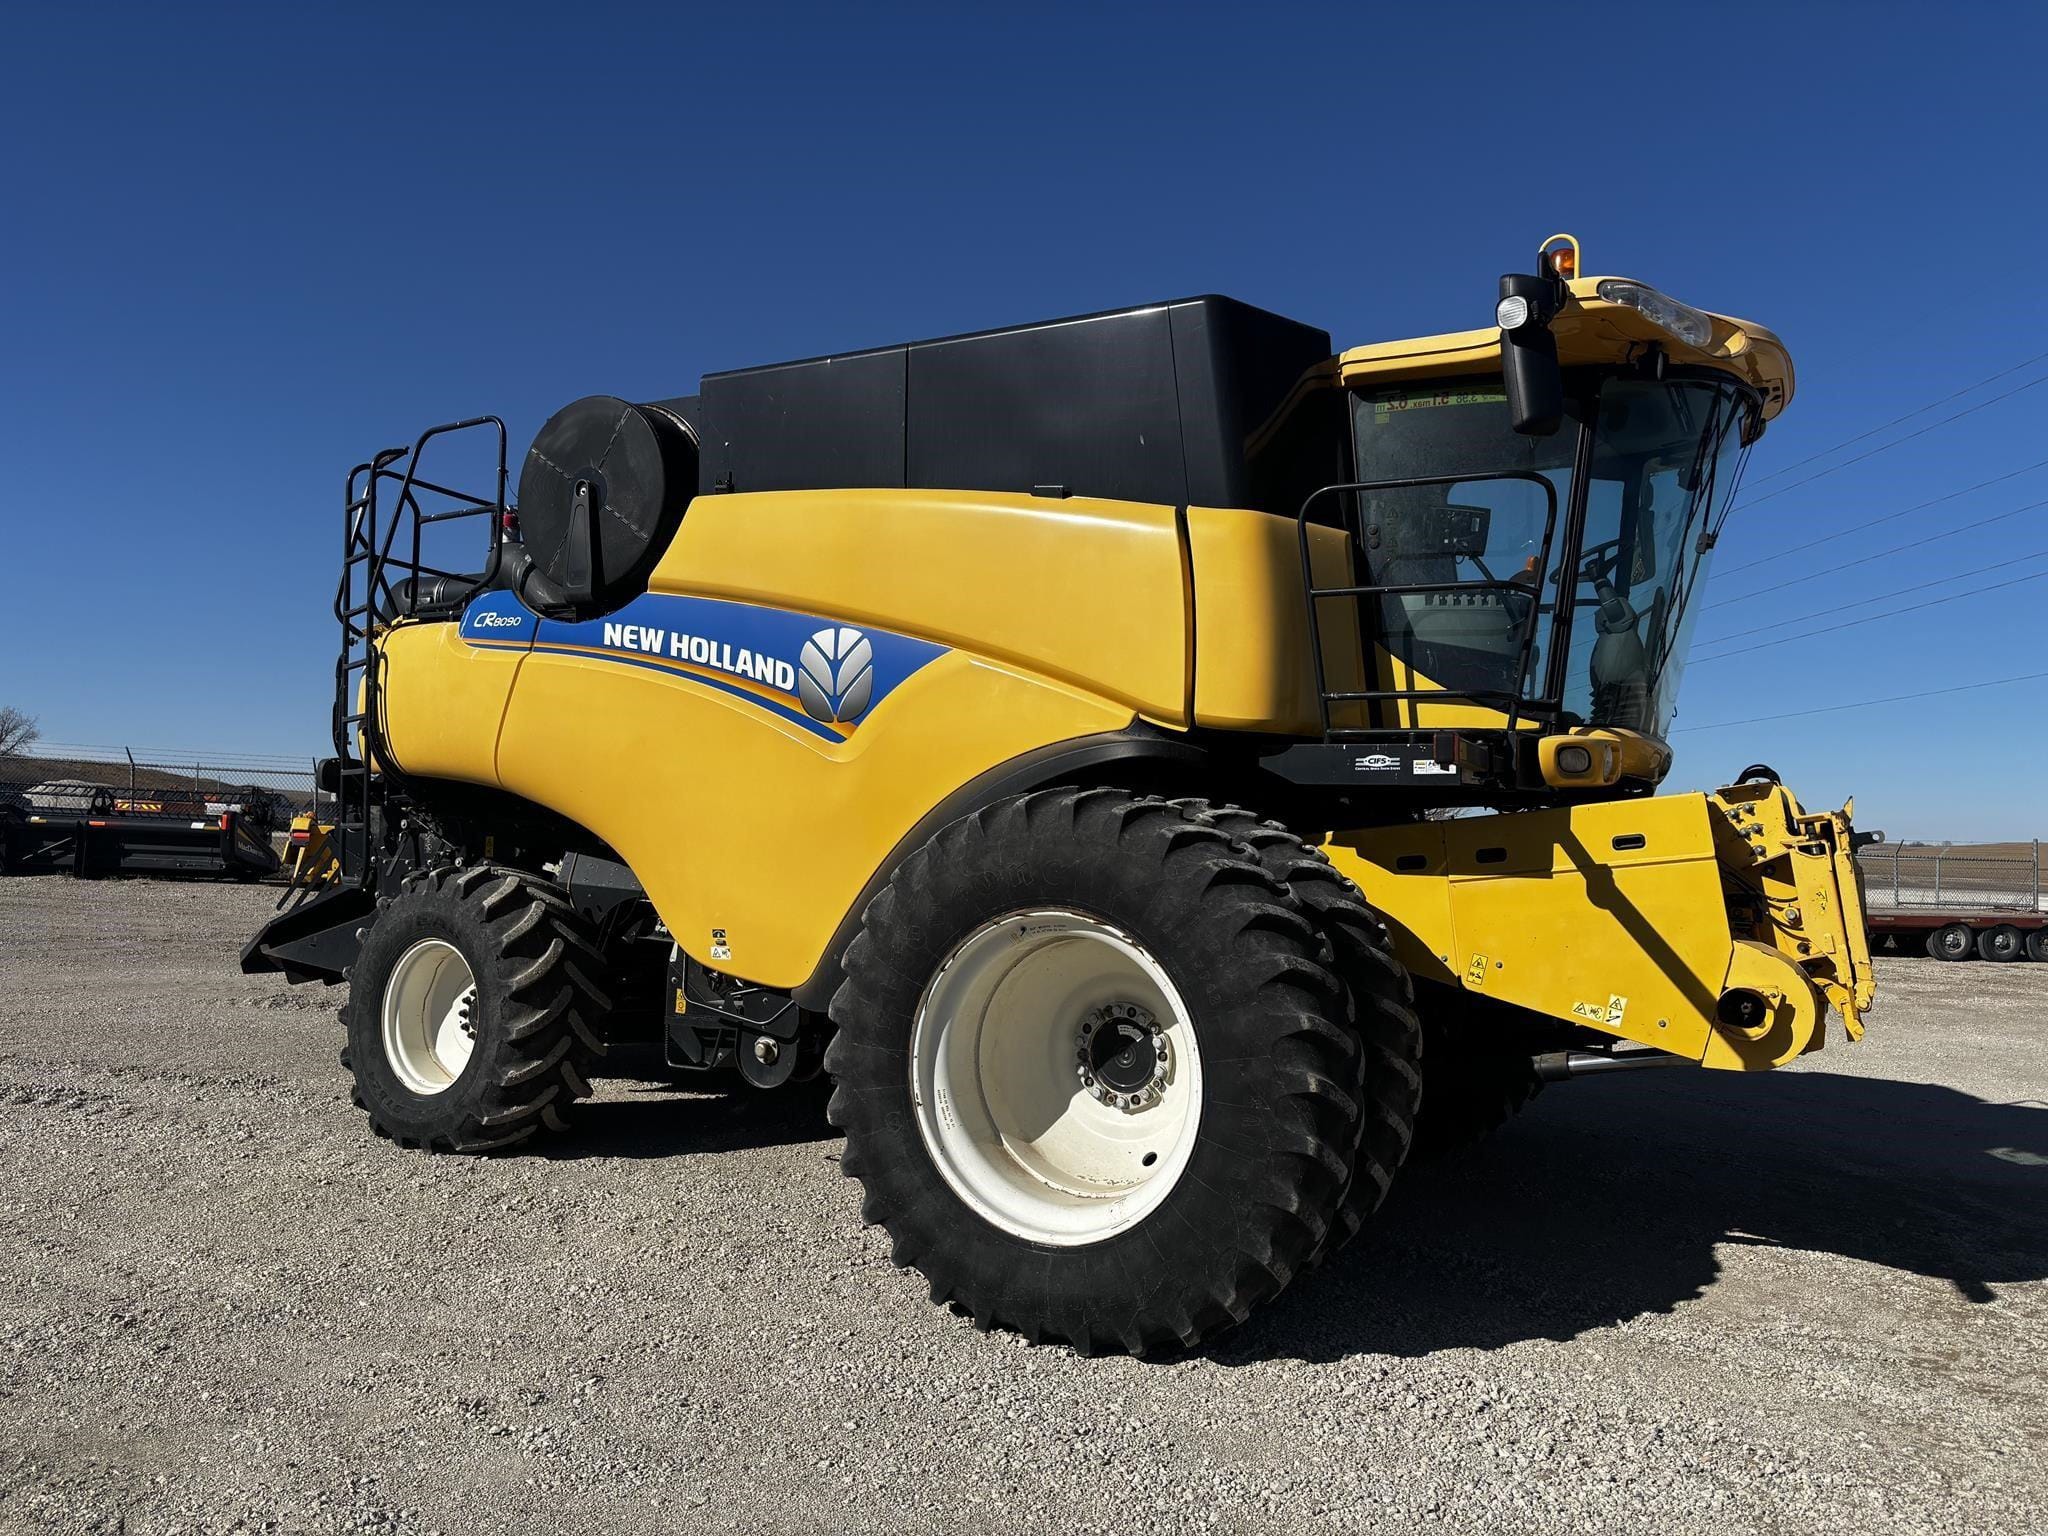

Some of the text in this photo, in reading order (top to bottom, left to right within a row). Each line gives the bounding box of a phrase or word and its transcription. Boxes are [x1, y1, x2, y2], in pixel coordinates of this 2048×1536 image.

[473, 612, 522, 628] CR8090
[603, 622, 796, 691] NEW HOLLAND
[1368, 757, 1387, 765] CIFS
